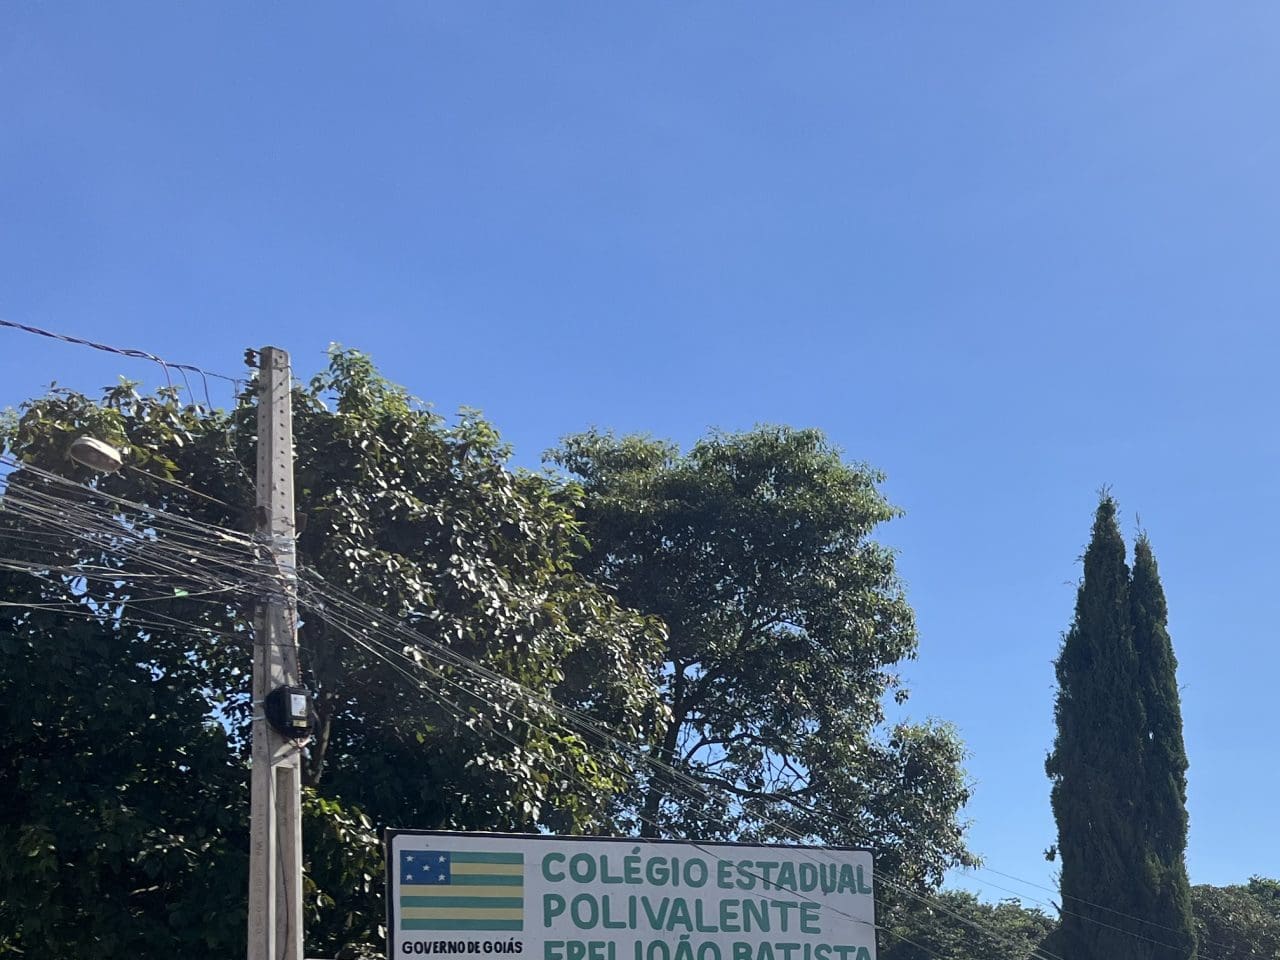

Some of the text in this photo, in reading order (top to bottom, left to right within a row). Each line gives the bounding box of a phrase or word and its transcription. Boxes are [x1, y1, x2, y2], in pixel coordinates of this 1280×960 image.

[541, 846, 873, 896] COLÉGIO ESTADUAL
[543, 893, 822, 934] POLIVALENTE
[402, 937, 523, 954] GOVERNO DE GOIÁS
